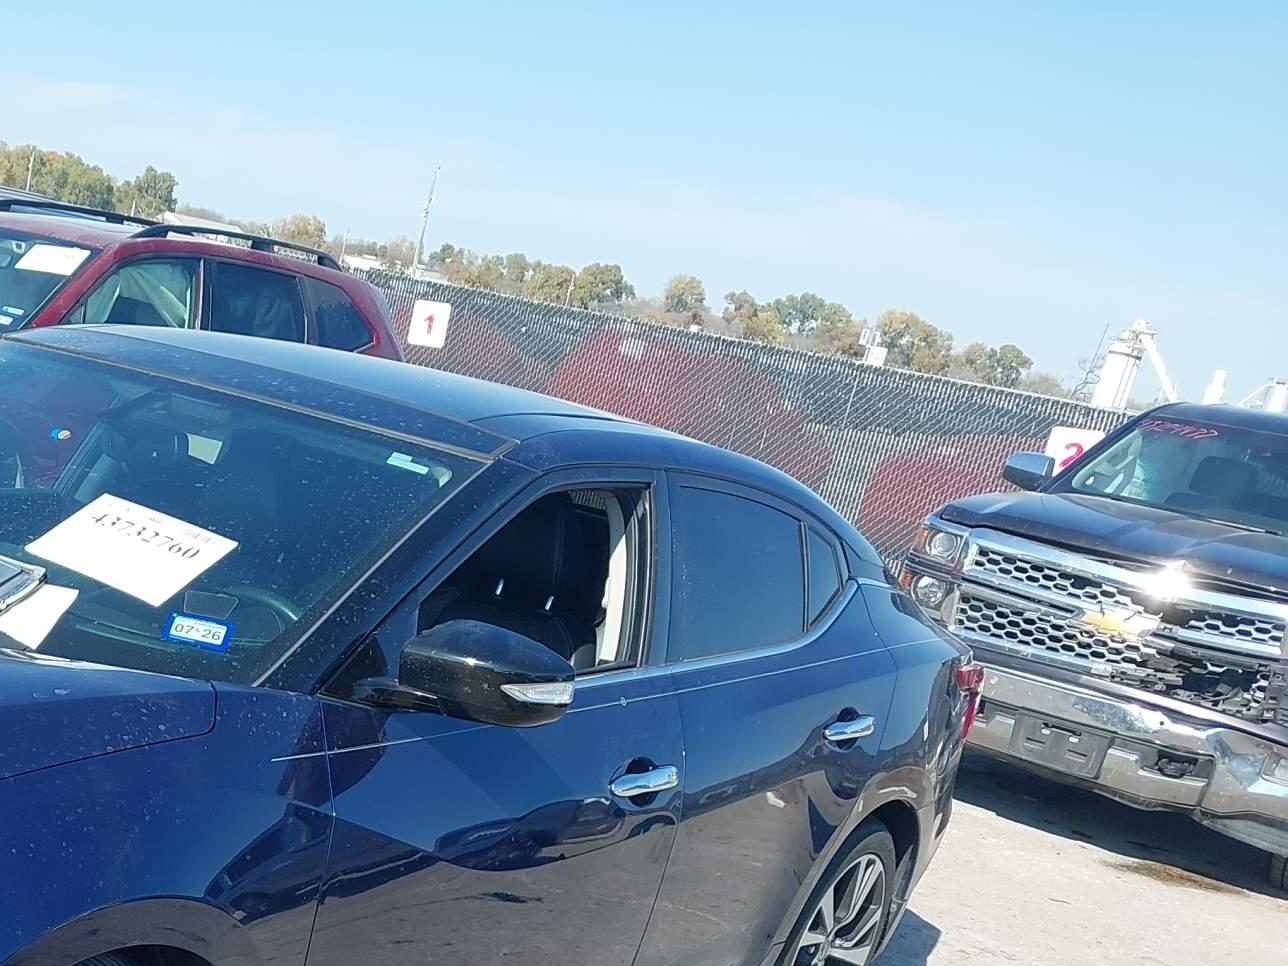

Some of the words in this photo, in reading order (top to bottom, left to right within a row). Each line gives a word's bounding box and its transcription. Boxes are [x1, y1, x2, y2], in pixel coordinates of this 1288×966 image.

[424, 314, 435, 335] 1
[1059, 442, 1084, 468] 2
[91, 513, 200, 559] 43732760
[174, 623, 194, 635] 07
[201, 628, 222, 641] 26
